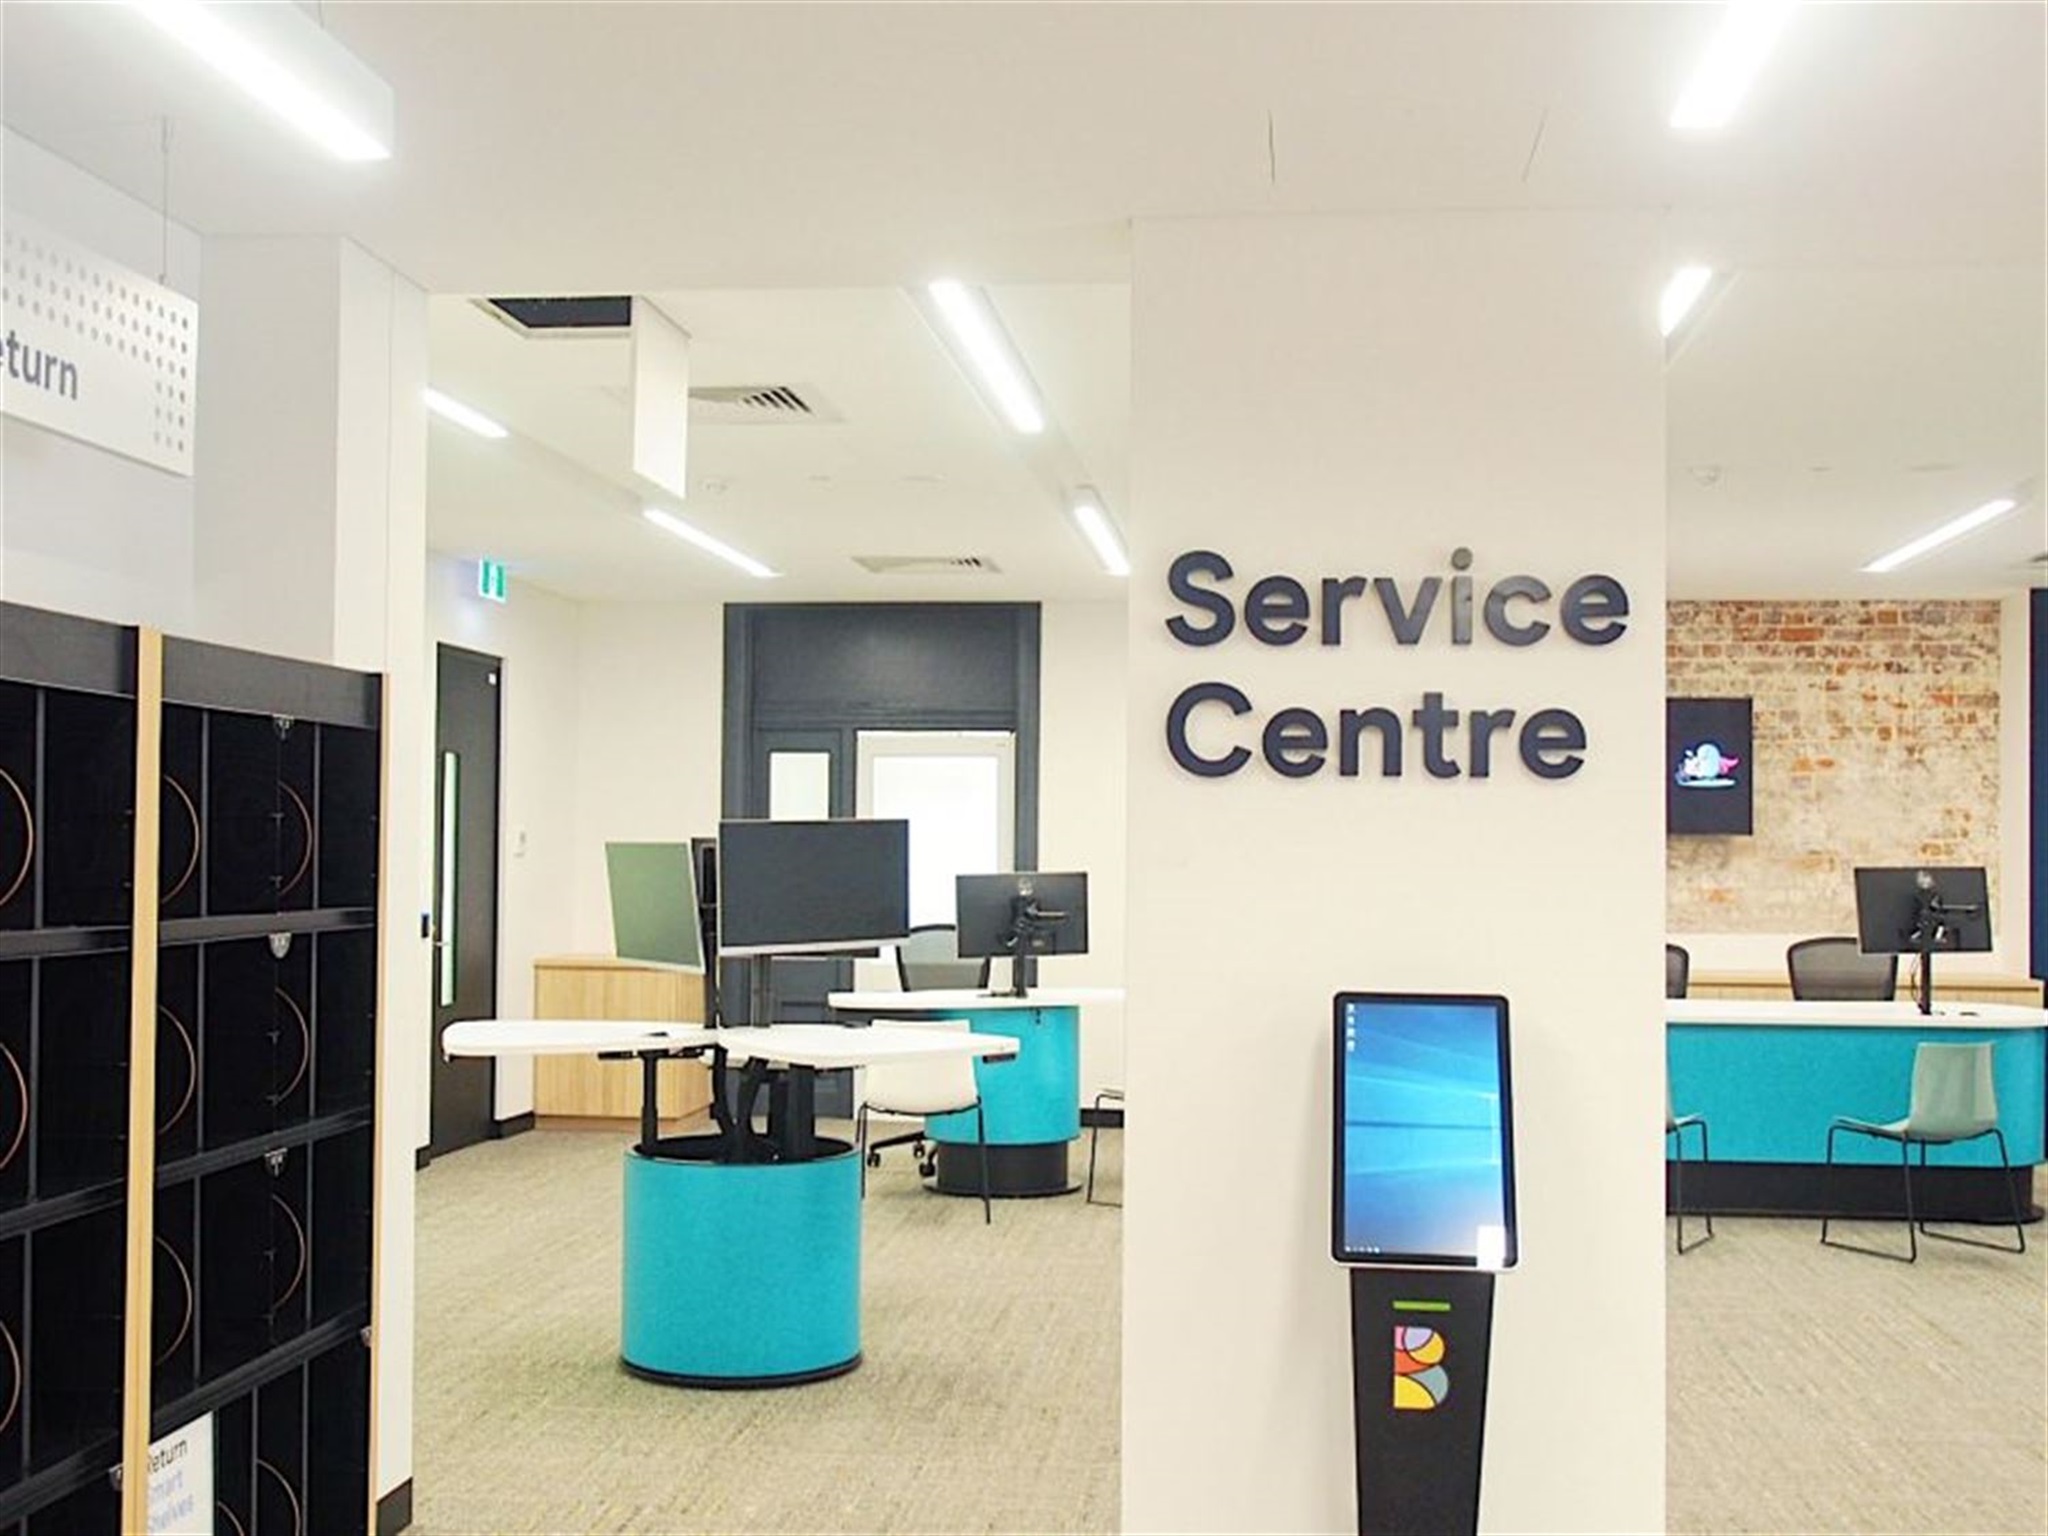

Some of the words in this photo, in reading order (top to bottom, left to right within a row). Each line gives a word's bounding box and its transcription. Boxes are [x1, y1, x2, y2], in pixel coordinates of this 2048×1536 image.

[0, 330, 77, 400] turn
[1165, 547, 1630, 647] Service
[1165, 681, 1586, 779] Centre
